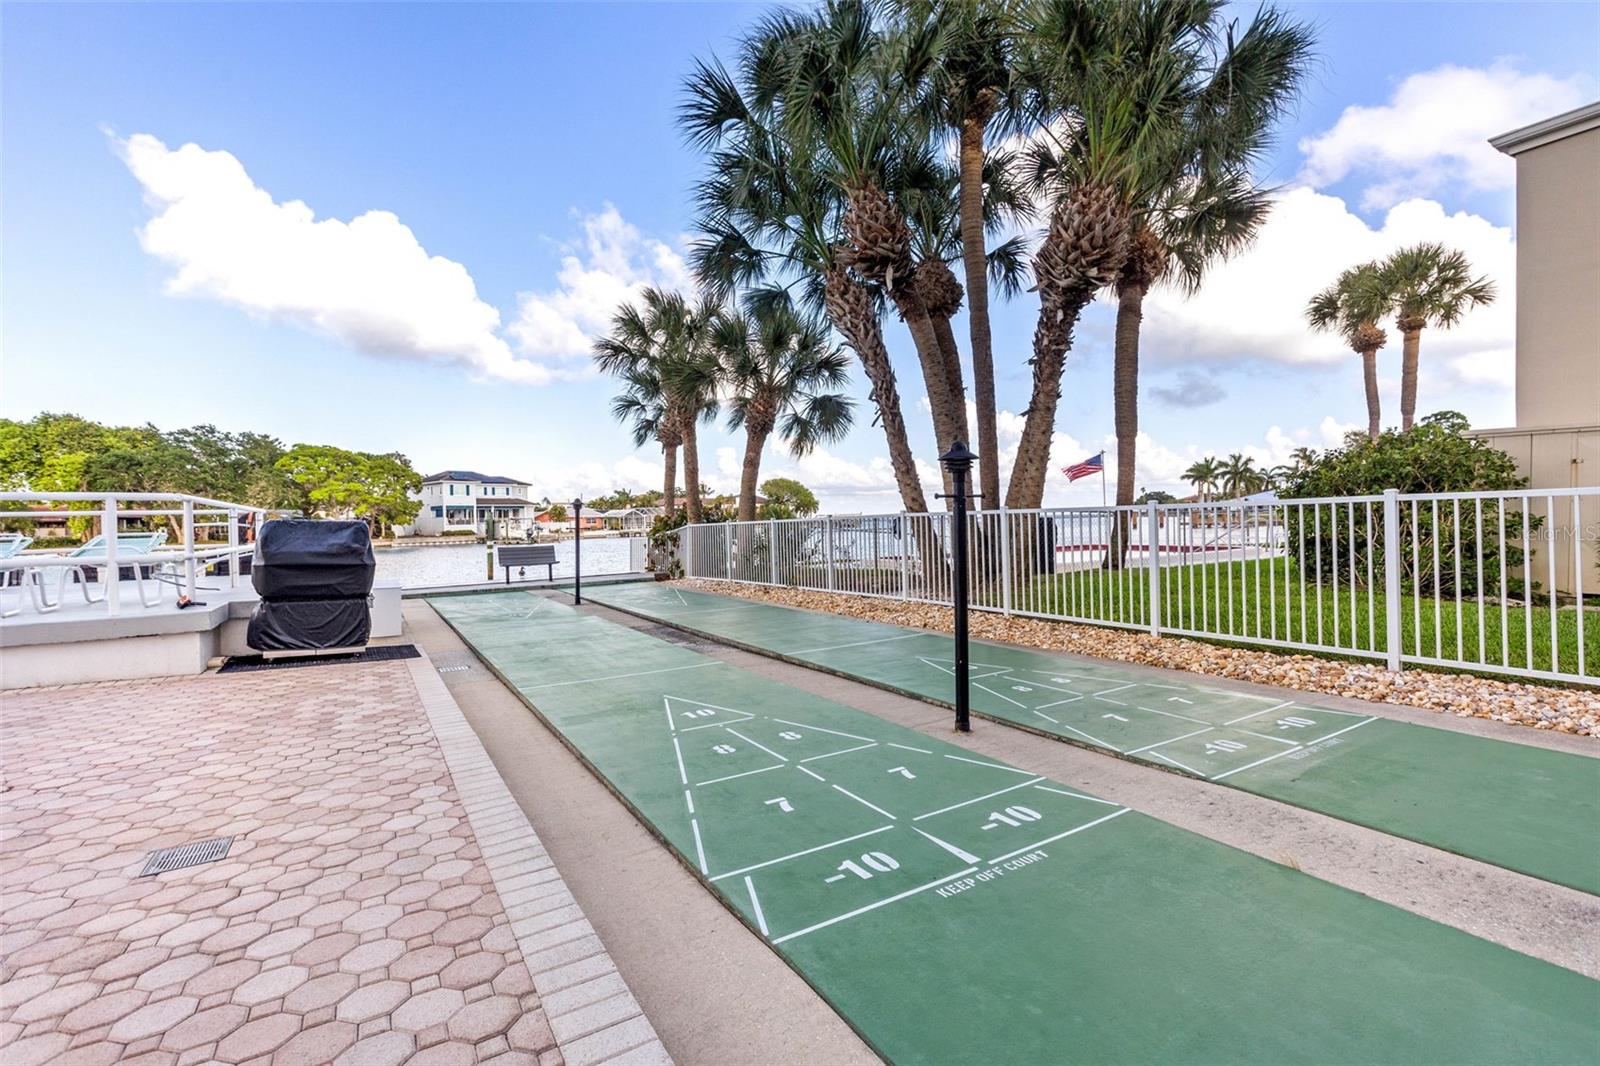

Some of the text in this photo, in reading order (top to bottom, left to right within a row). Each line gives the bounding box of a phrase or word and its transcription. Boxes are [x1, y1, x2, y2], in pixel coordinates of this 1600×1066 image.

[680, 709, 716, 719] 10
[1276, 716, 1317, 729] -10
[778, 731, 802, 740] 8
[712, 744, 737, 754] 8
[1205, 739, 1248, 755] -10
[887, 766, 916, 779] 7
[764, 797, 795, 812] 7
[981, 805, 1042, 830] -10
[824, 852, 900, 884] -10
[935, 849, 1049, 898] KEEP OFF COURT
